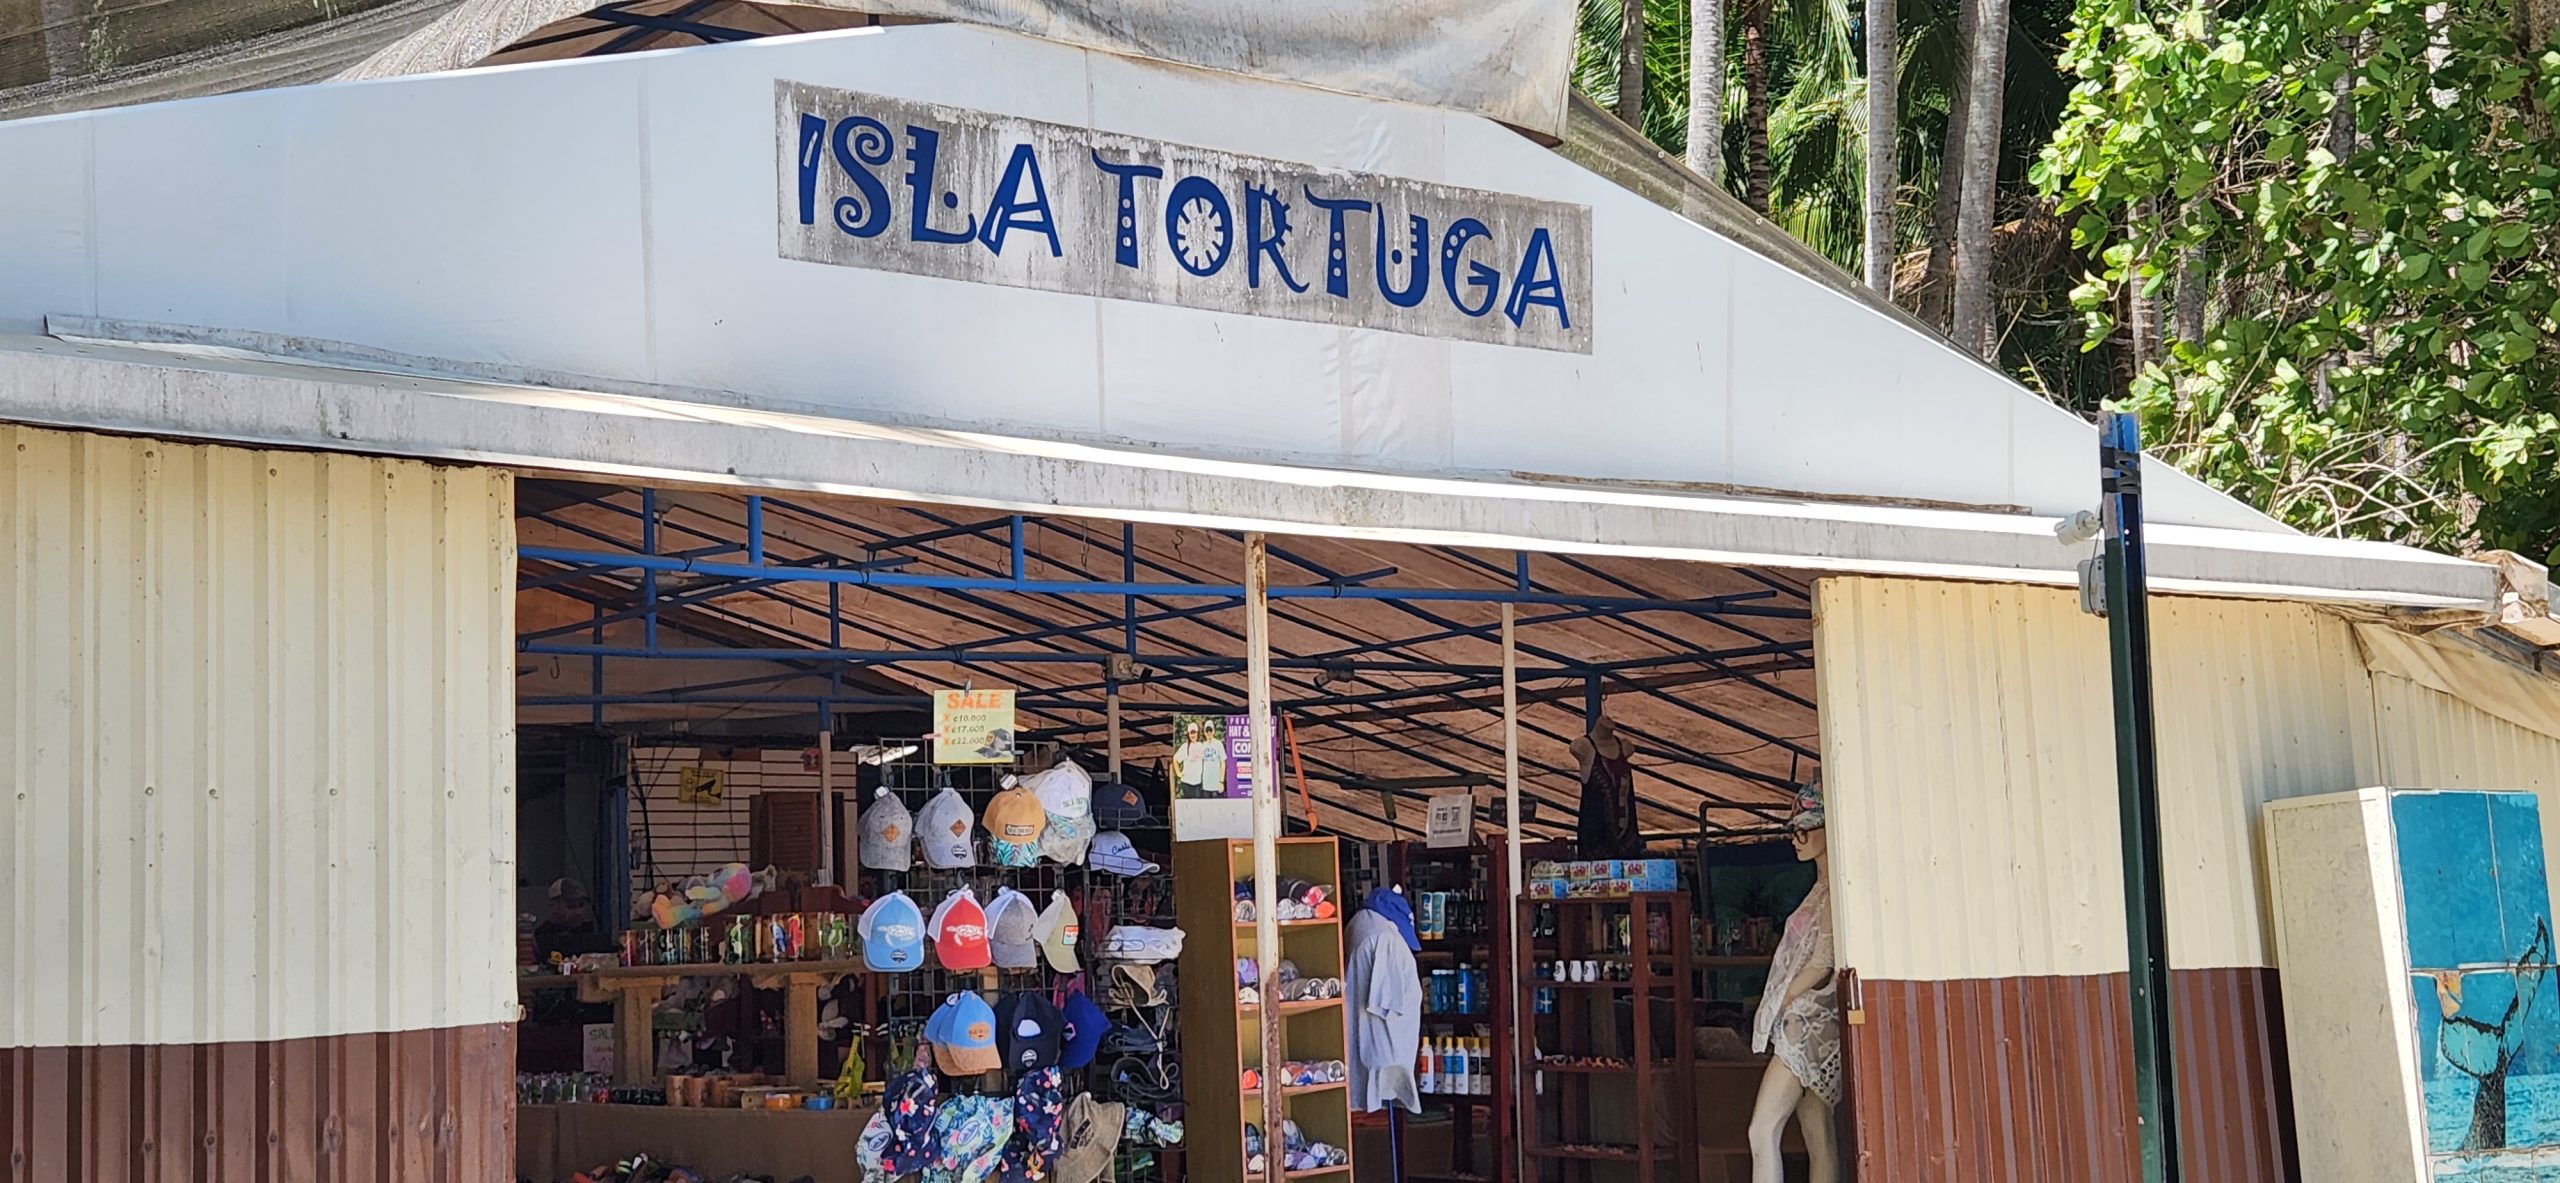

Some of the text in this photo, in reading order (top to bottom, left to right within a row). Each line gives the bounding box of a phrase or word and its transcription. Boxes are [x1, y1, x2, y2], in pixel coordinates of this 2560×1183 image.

[800, 112, 1570, 329] ISLA TORTUGA
[947, 692, 1001, 709] SALE
[1229, 725, 1241, 737] HAT
